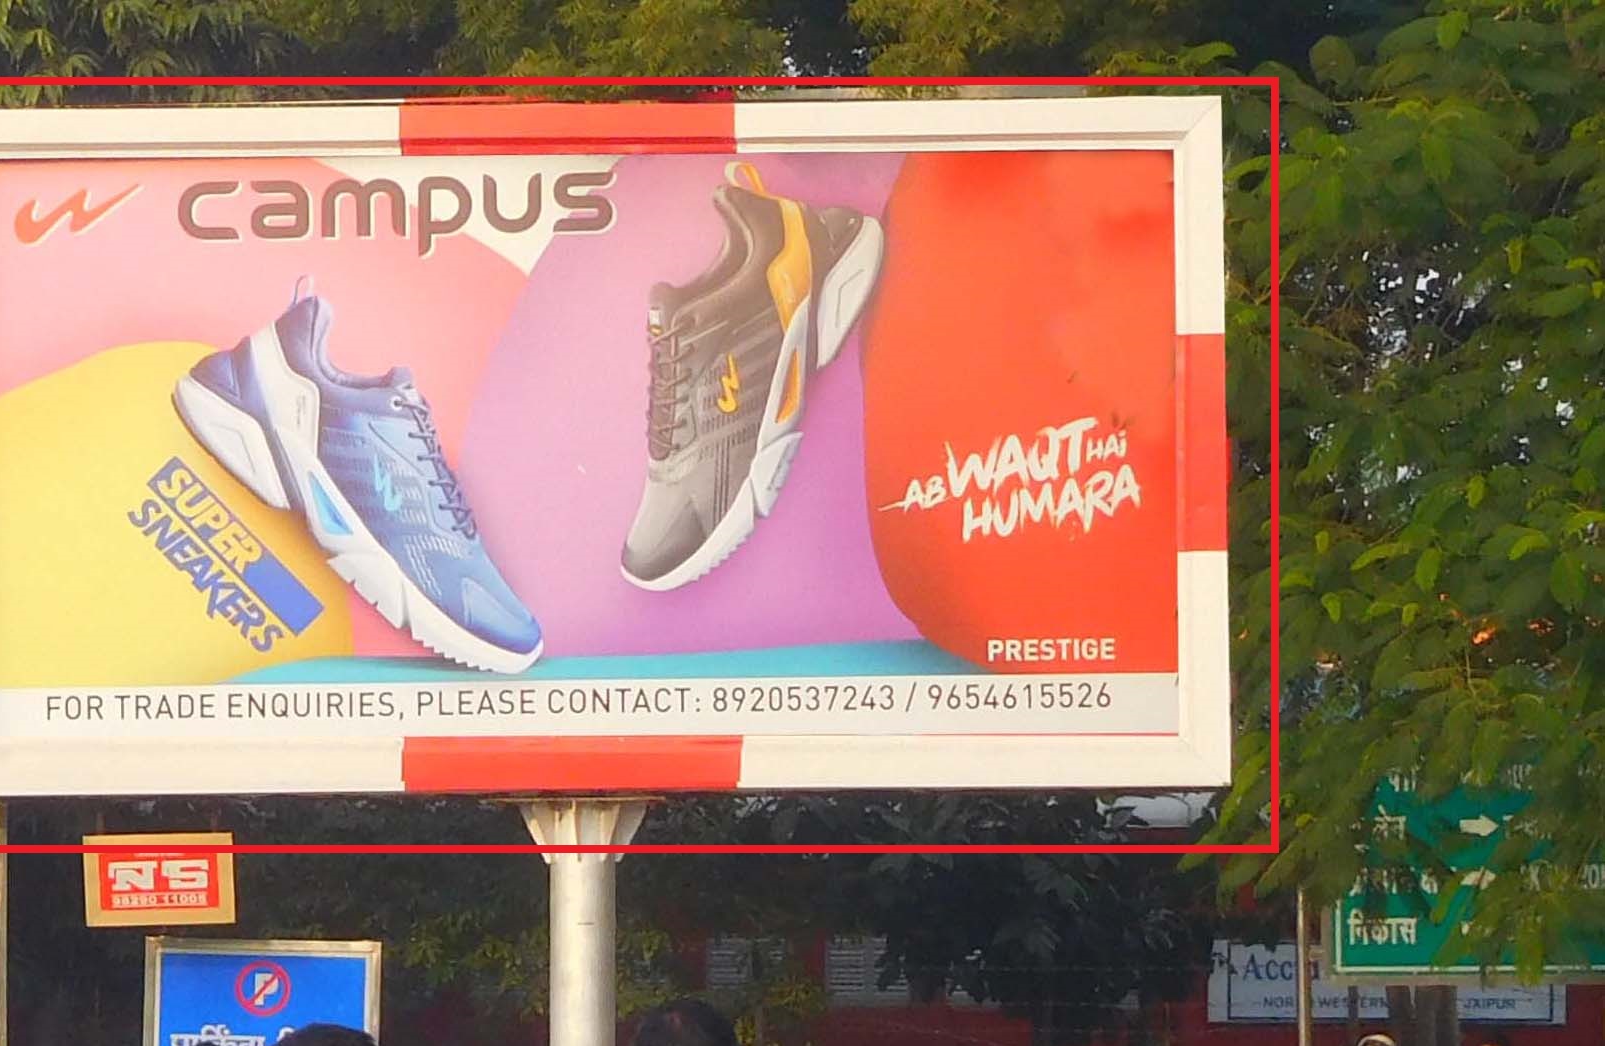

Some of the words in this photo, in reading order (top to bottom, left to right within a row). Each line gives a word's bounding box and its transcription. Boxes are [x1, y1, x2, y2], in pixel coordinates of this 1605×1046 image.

[177, 171, 616, 258] campus
[884, 475, 946, 514] AB
[945, 417, 1098, 497] WAQT
[961, 464, 1141, 543] HUMARA
[156, 467, 263, 576] SUPER
[127, 498, 285, 653] SNEAKERS
[987, 638, 1116, 662] PRESTIGE
[46, 695, 105, 721] FOR
[114, 693, 217, 720] TRADE
[227, 690, 405, 722] ENQUIRIES,
[417, 688, 537, 717] PLEASE
[712, 683, 896, 713] 8920537243
[927, 681, 1112, 712] 9654615526
